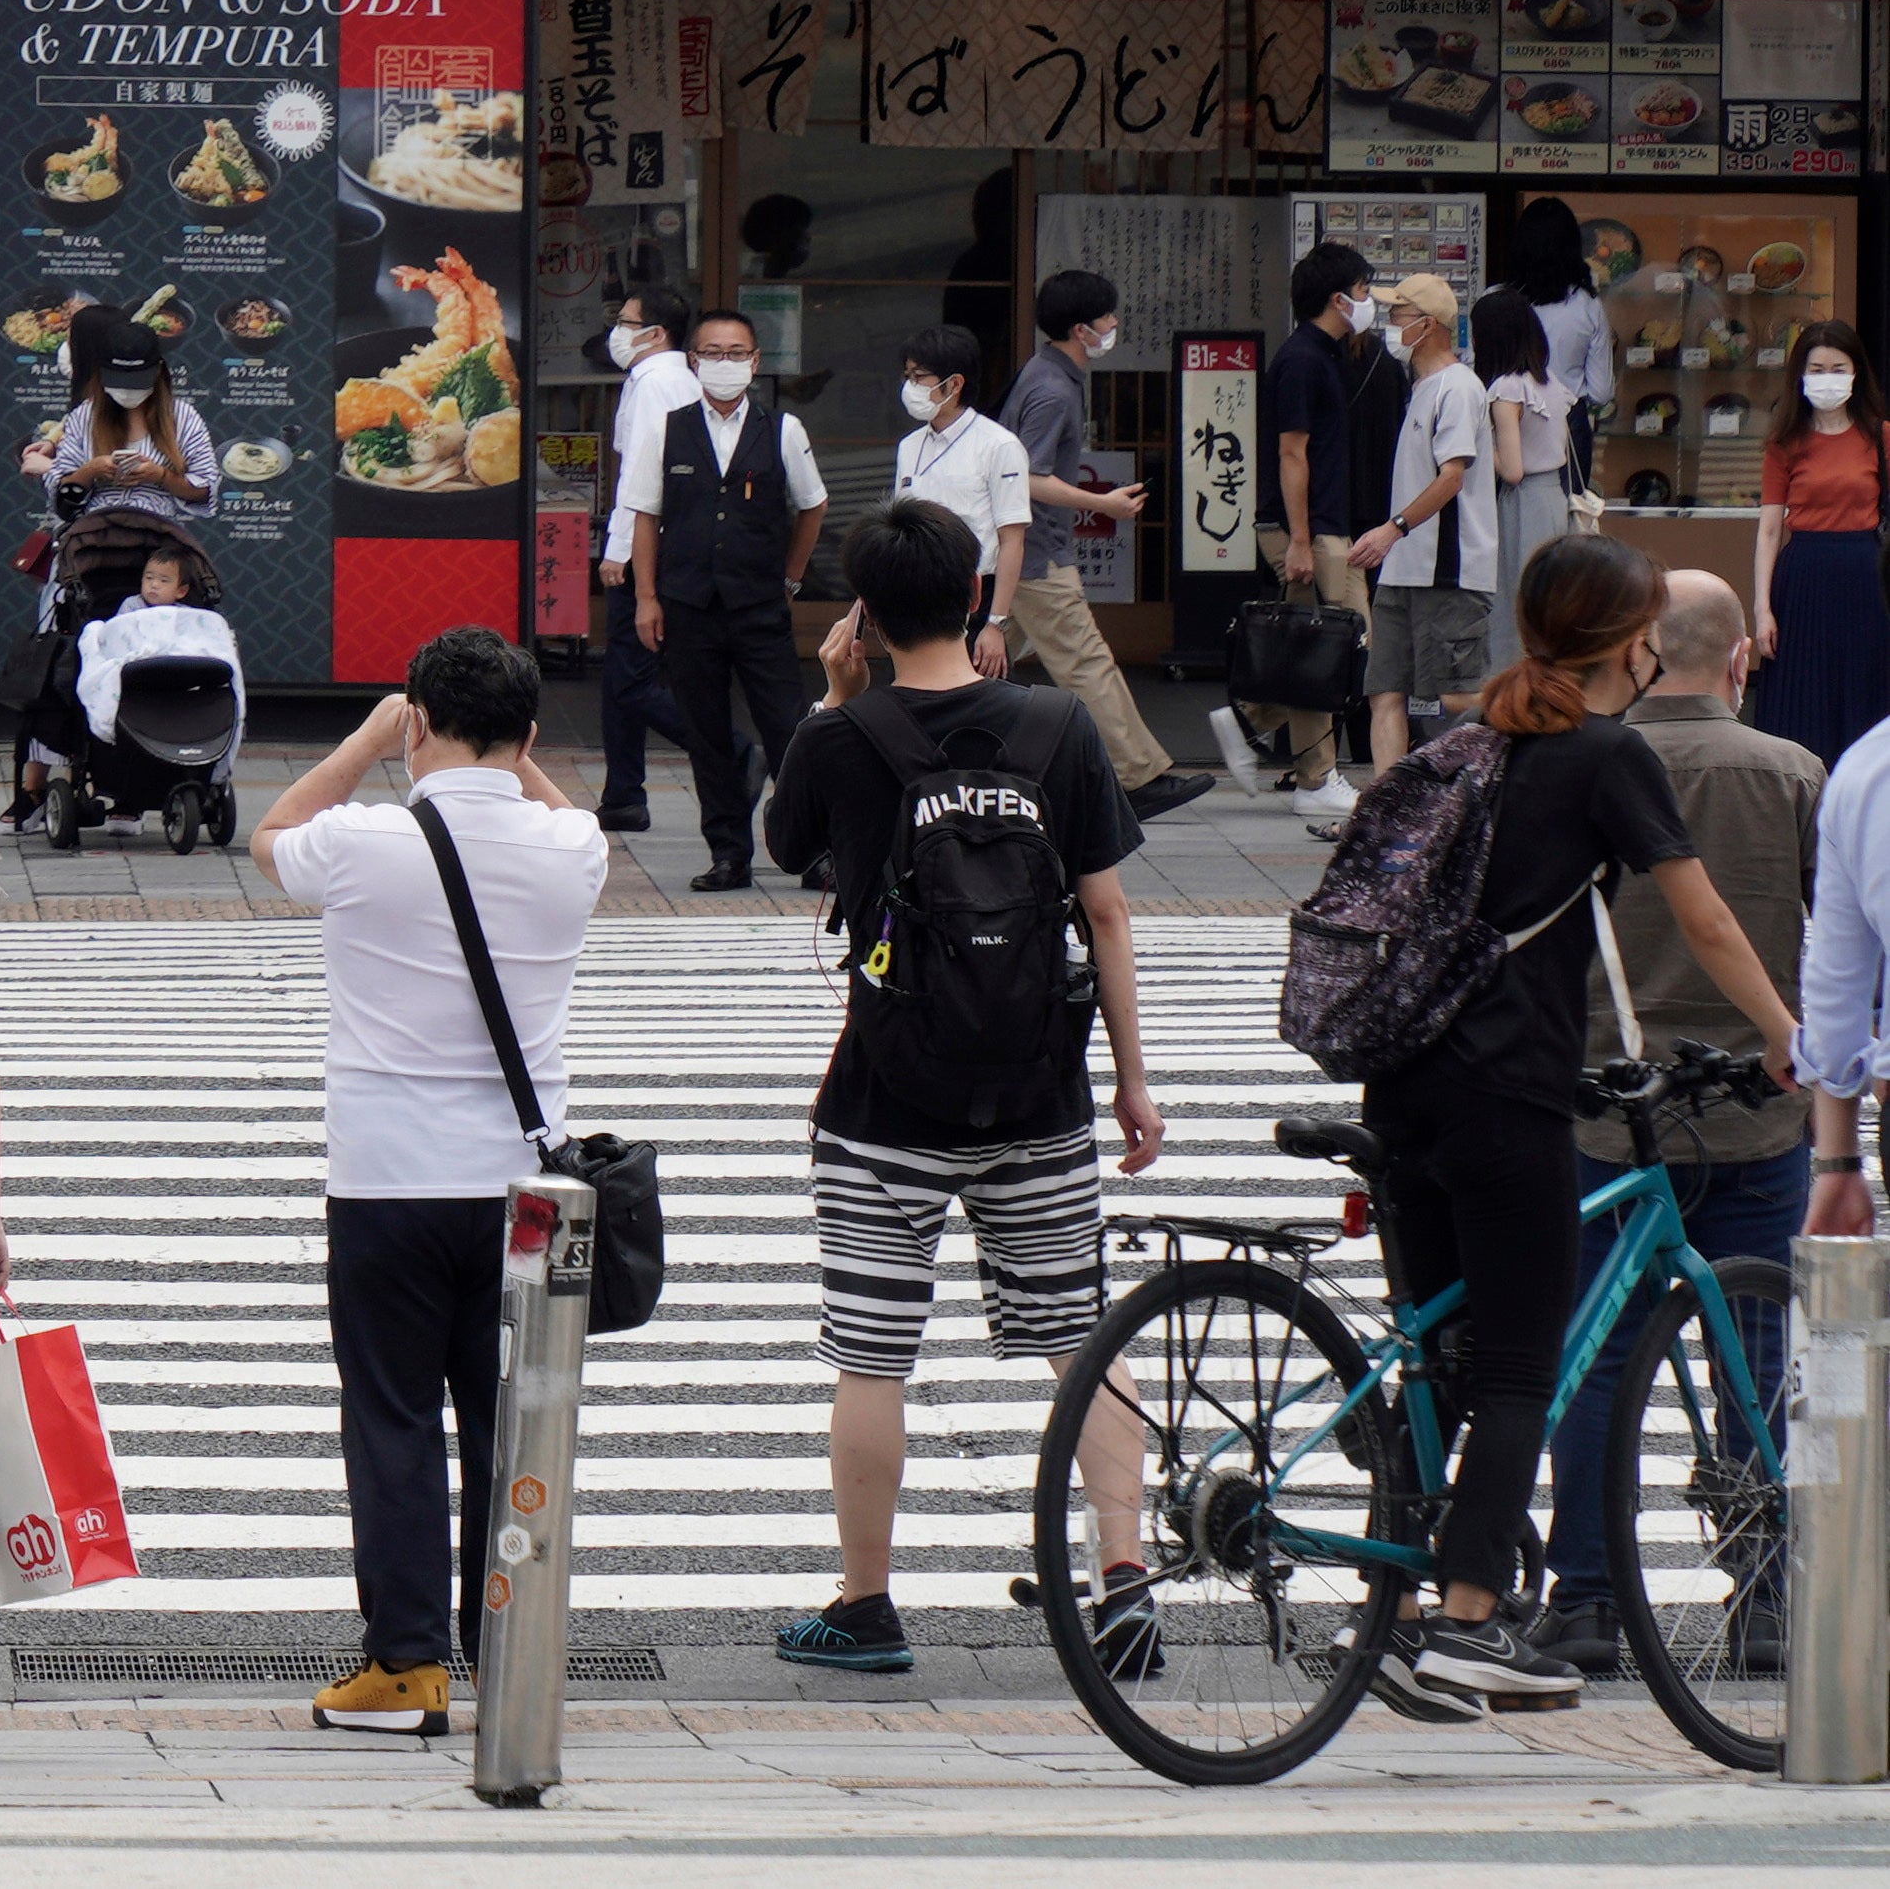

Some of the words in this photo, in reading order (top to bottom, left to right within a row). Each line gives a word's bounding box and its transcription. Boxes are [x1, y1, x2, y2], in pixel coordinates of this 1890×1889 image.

[20, 24, 60, 64] &
[77, 24, 330, 69] TEMPURA
[1186, 344, 1219, 369] B1F
[1190, 418, 1247, 542] ねぎし
[914, 784, 1045, 832] MILKFED.
